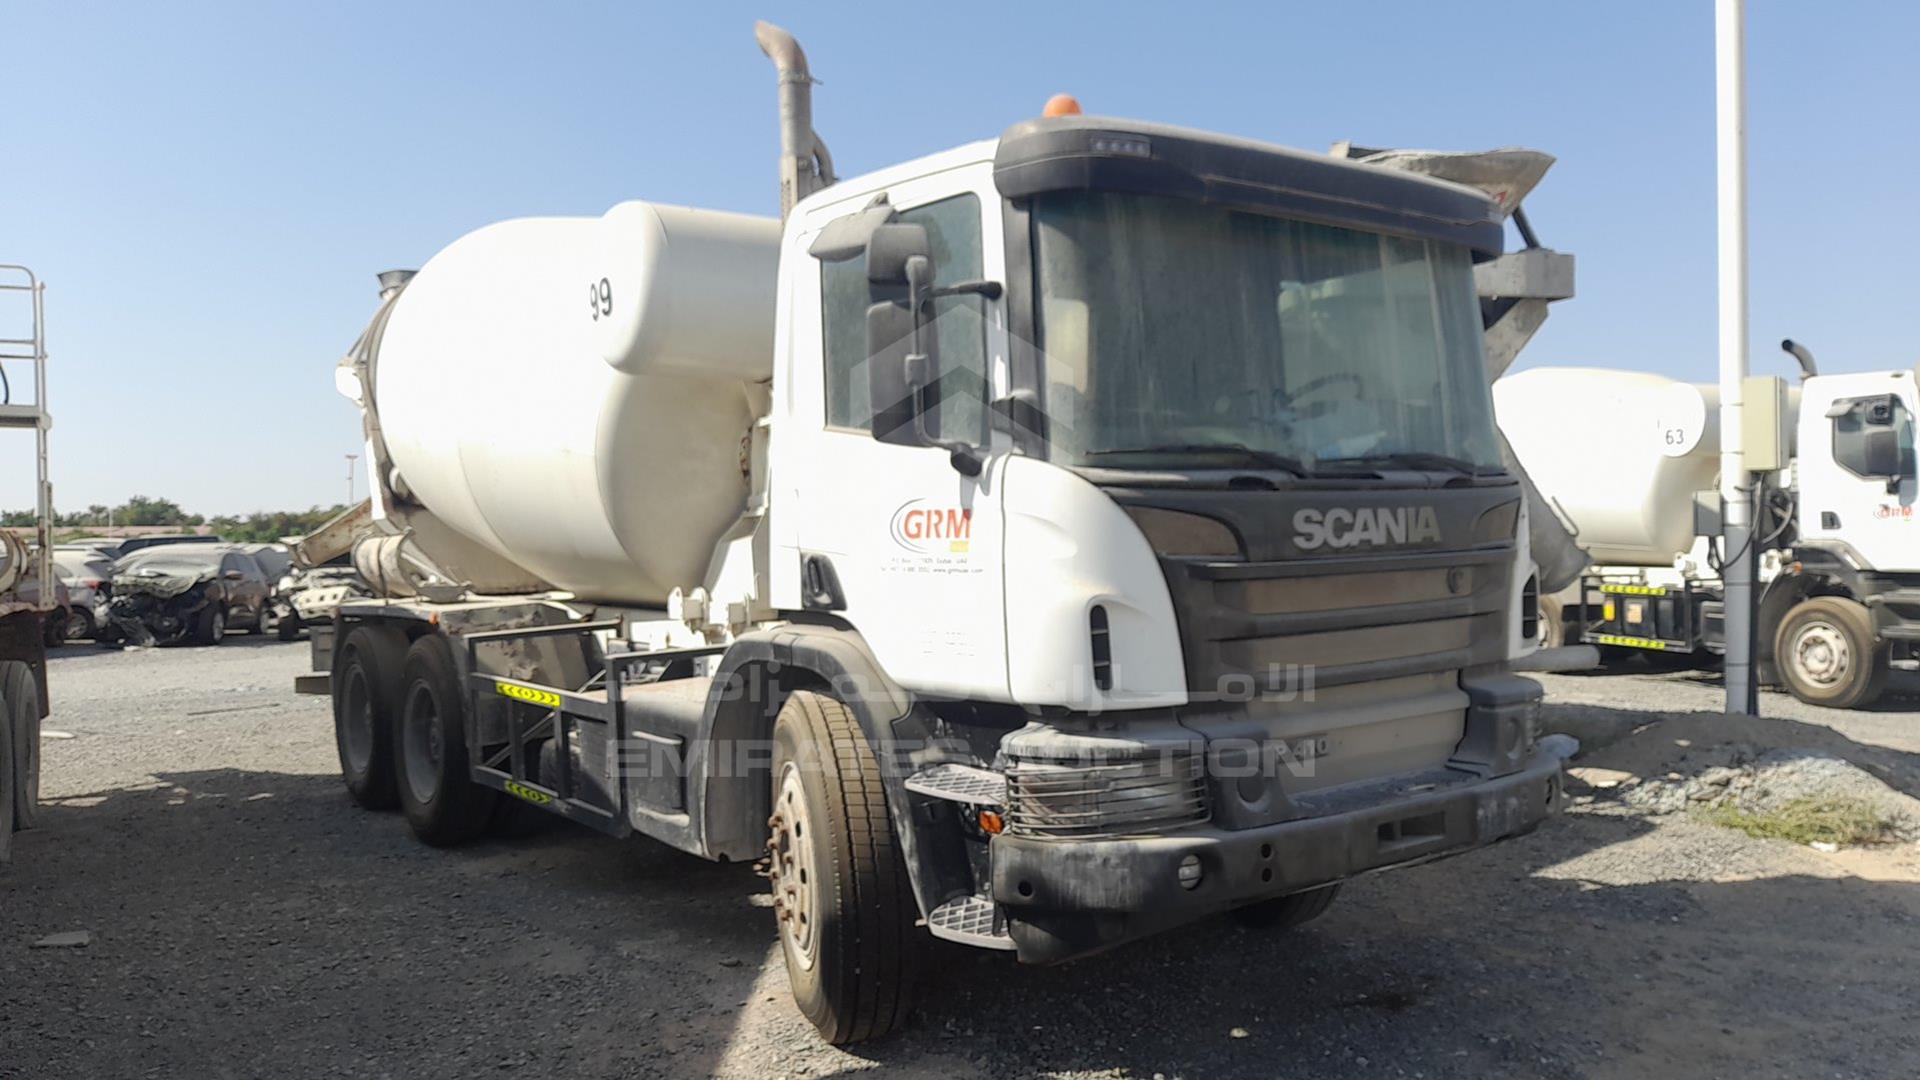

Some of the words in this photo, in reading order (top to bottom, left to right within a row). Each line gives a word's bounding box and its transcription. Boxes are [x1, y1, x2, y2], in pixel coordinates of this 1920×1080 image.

[590, 277, 612, 321] 99
[1665, 429, 1684, 445] 63
[904, 509, 971, 539] GRM
[1292, 506, 1441, 549] SCANIA
